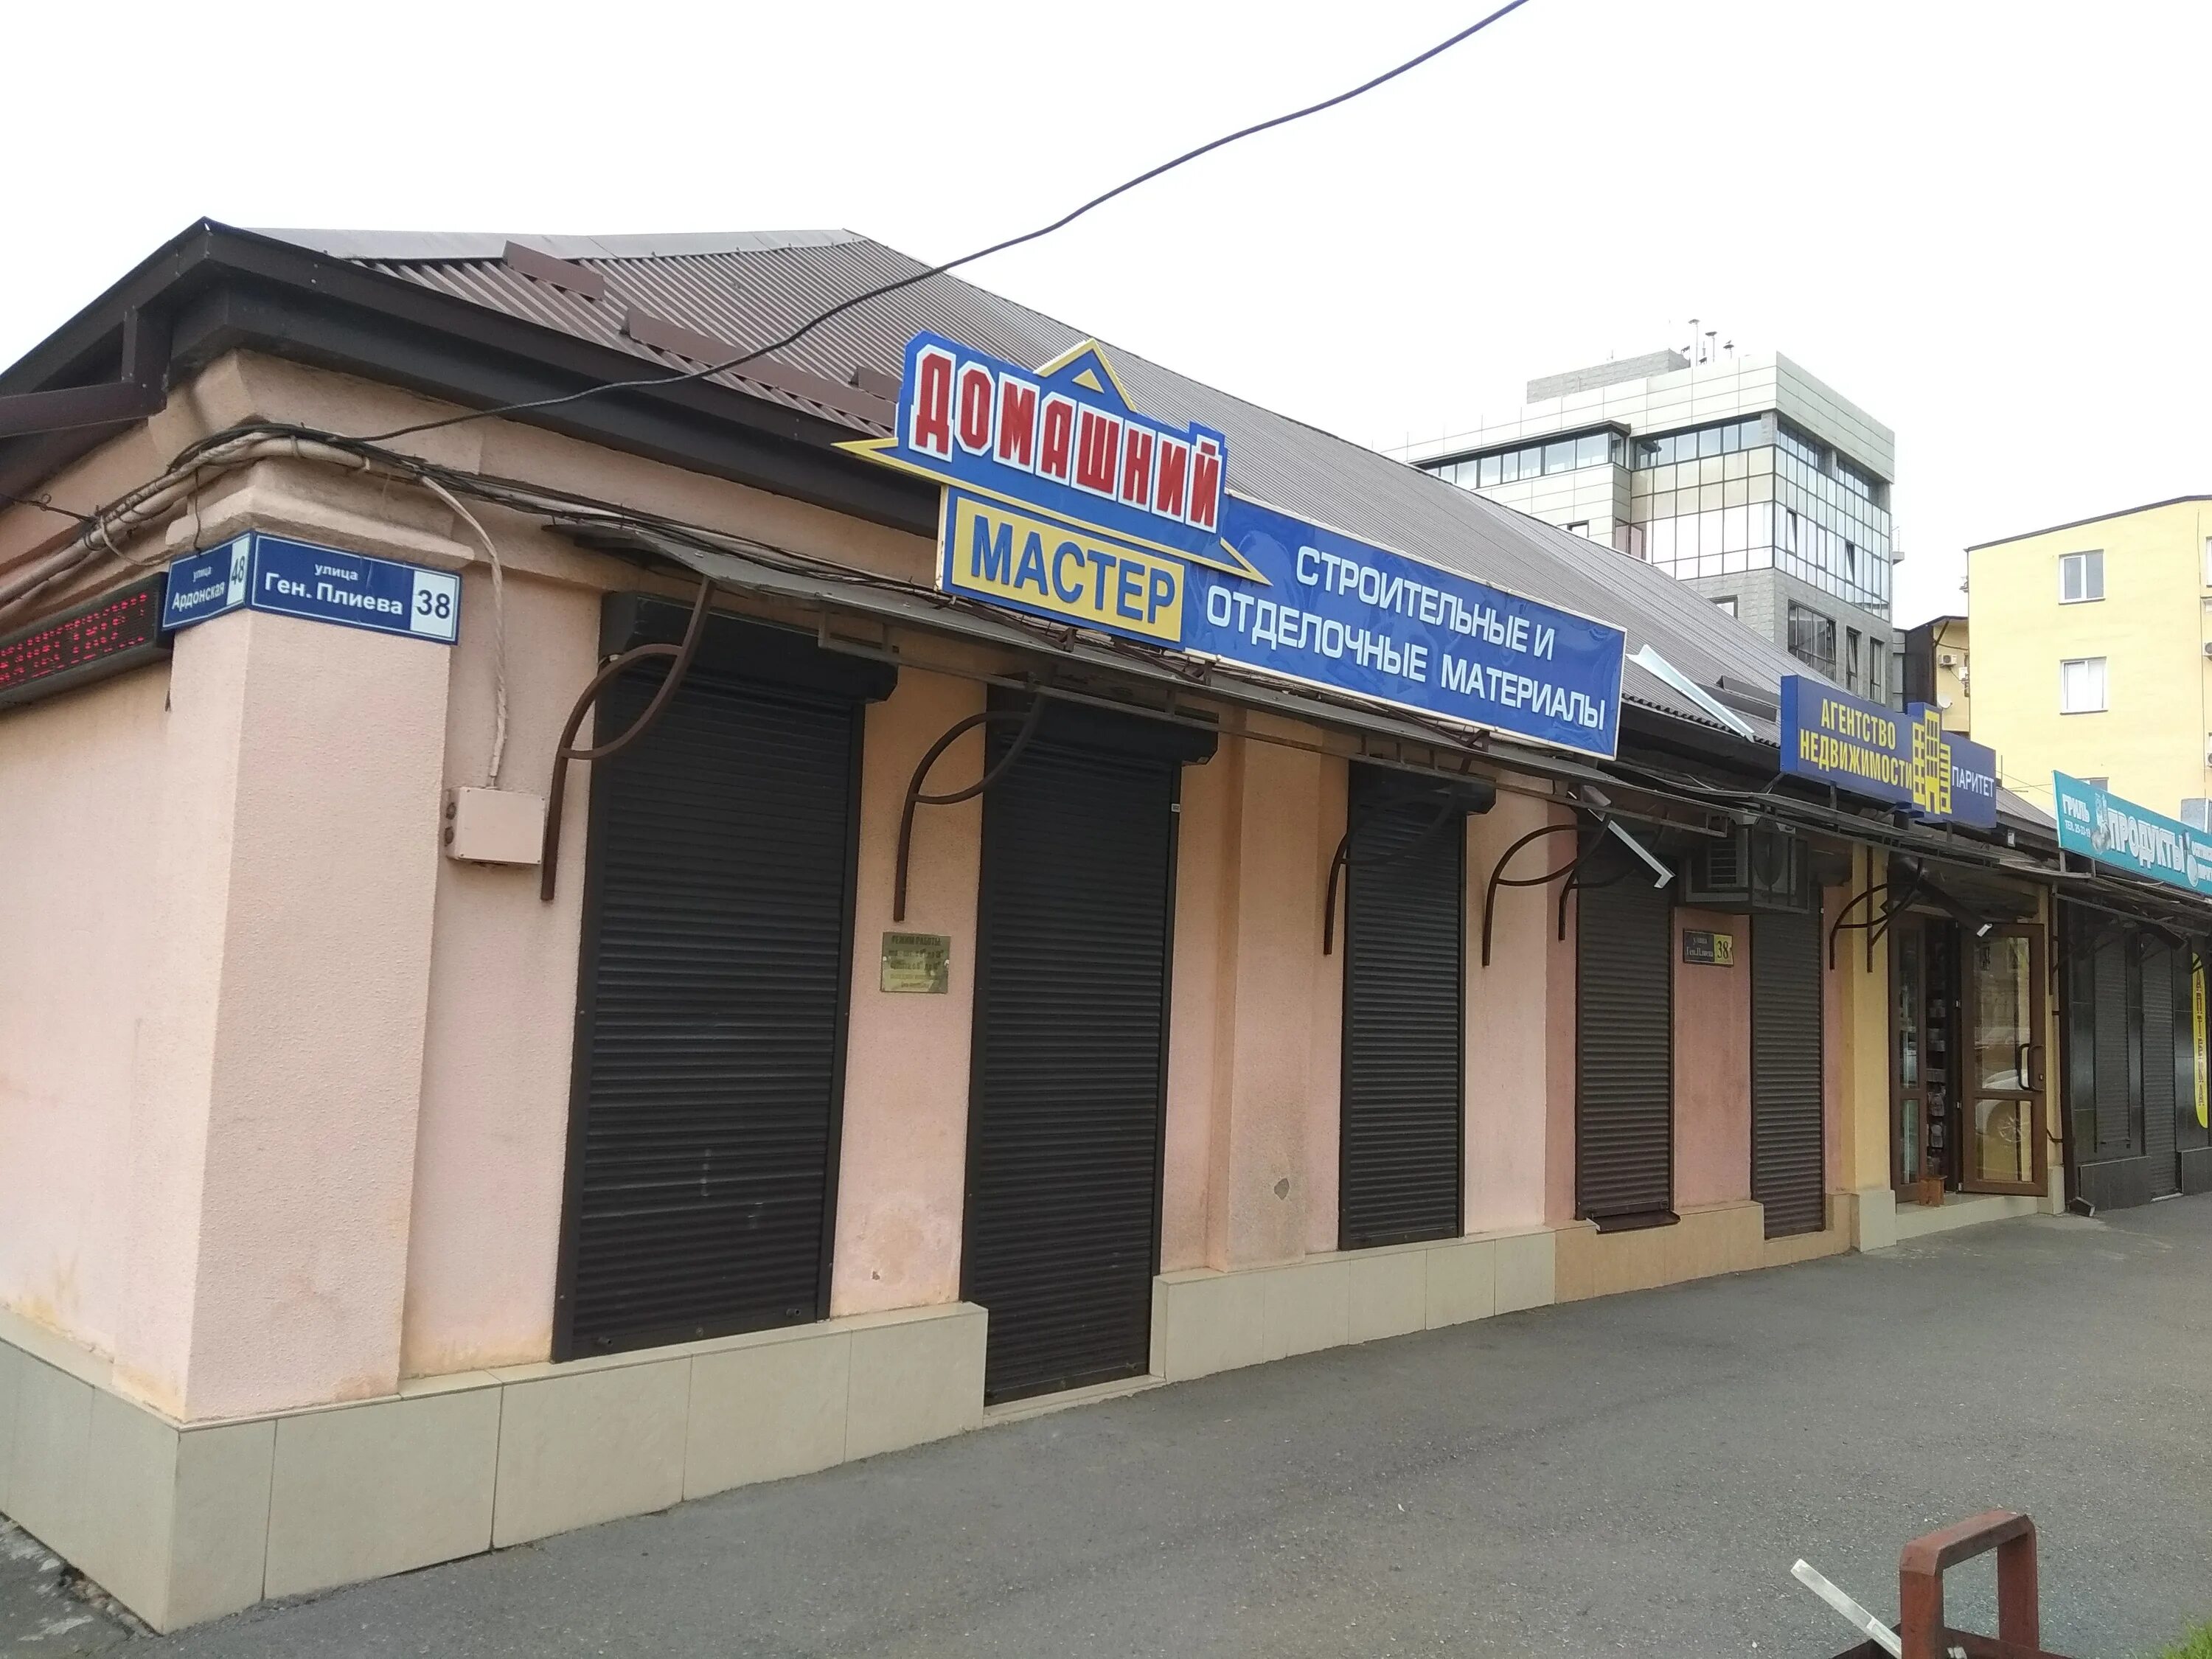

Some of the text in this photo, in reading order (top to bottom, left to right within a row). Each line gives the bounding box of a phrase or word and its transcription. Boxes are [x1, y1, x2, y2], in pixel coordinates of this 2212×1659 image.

[910, 345, 1221, 532] ДОМАШНИЙ
[193, 566, 212, 582] улица
[231, 555, 246, 585] 48
[314, 563, 359, 581] улица
[971, 515, 1175, 625] МАСТЕР
[172, 581, 225, 612] Ардонская
[264, 571, 403, 615] Ген. Плиева
[416, 589, 451, 619] 38
[1296, 546, 1555, 661] СТРОИТЕЛЬНЫЕ И
[1206, 585, 1606, 731] ОТДЕЛОЧНЫЕ МАТЕРИАЛЫ
[1820, 698, 1896, 751] АГЕНТСТВО
[1800, 728, 1913, 790] НЕДВИЖИМОСТИ
[1952, 765, 1994, 798] ПАРИТЕТ
[2062, 793, 2090, 823] ГРИЛЬ
[2107, 807, 2185, 874] ПРОДУКТЫ
[1717, 940, 1729, 959] 38
[2196, 970, 2204, 1106] АПТЕКА
